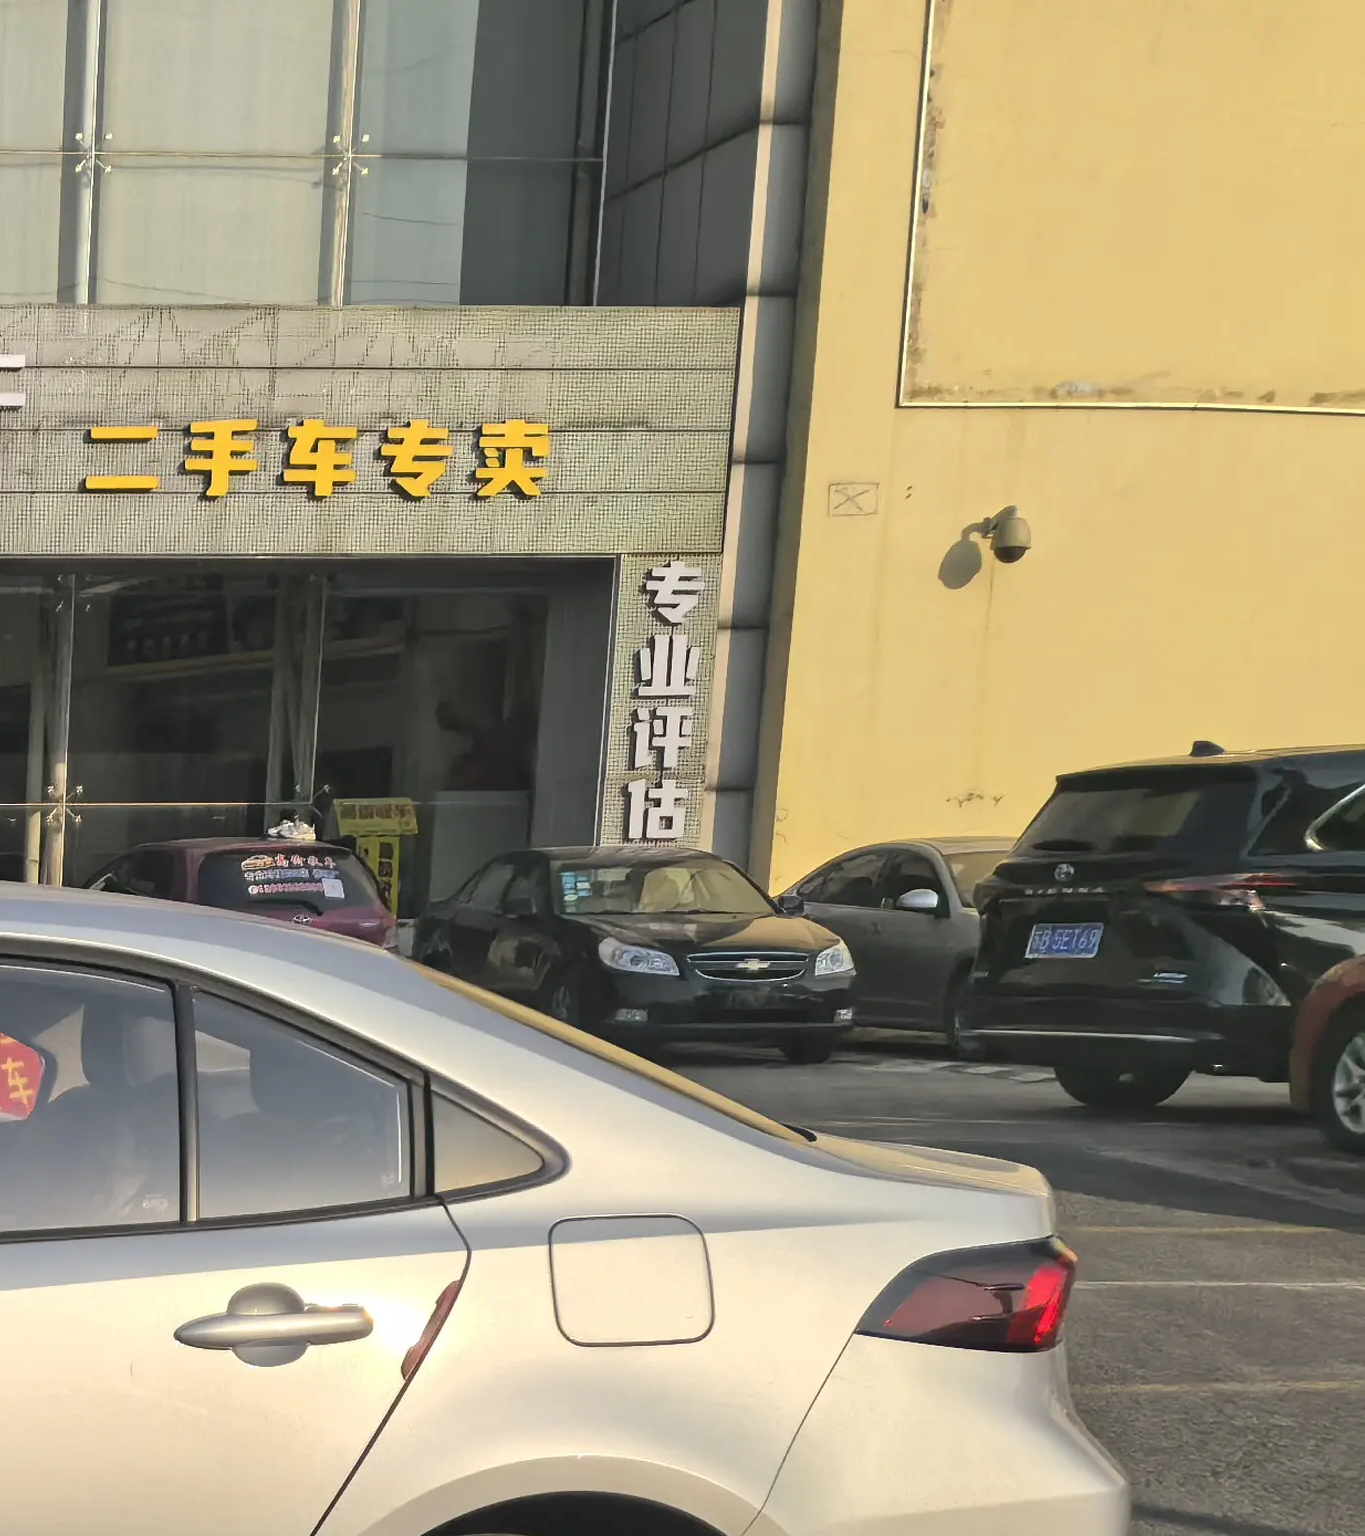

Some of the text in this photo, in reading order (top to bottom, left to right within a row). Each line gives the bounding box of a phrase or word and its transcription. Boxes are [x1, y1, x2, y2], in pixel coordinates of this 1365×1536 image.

[84, 418, 551, 498] 二手车专卖
[627, 560, 706, 840] 专业评估
